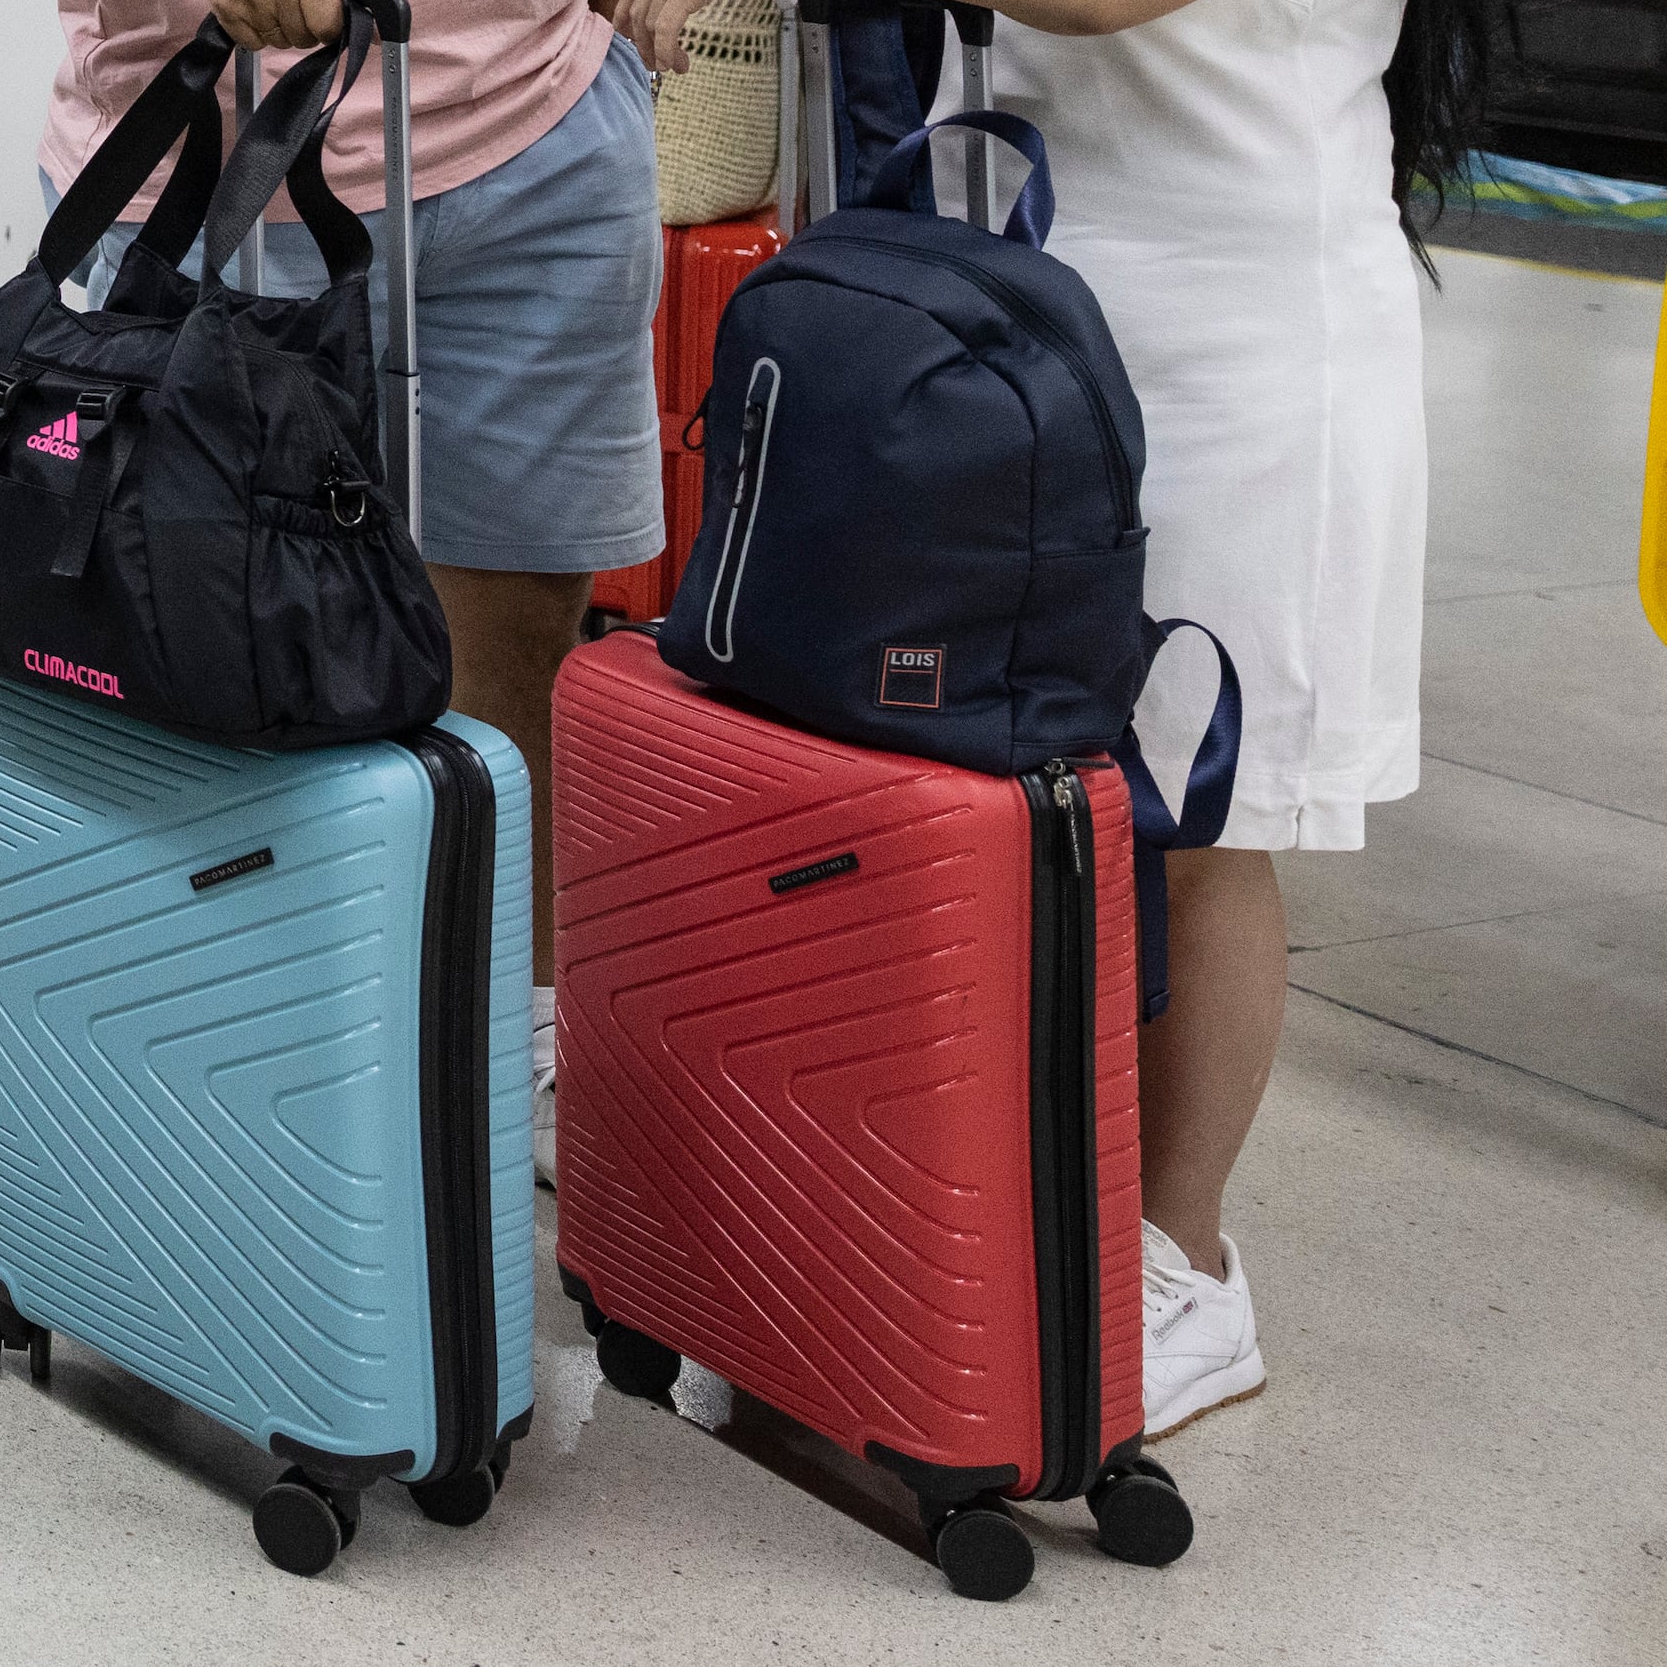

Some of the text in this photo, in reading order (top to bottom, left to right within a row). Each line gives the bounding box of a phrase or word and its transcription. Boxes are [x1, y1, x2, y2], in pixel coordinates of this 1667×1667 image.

[26, 433, 81, 462] adidas
[24, 648, 125, 700] CLIMACOOL
[890, 652, 935, 667] LOIS
[1151, 1310, 1185, 1341] Reebok
